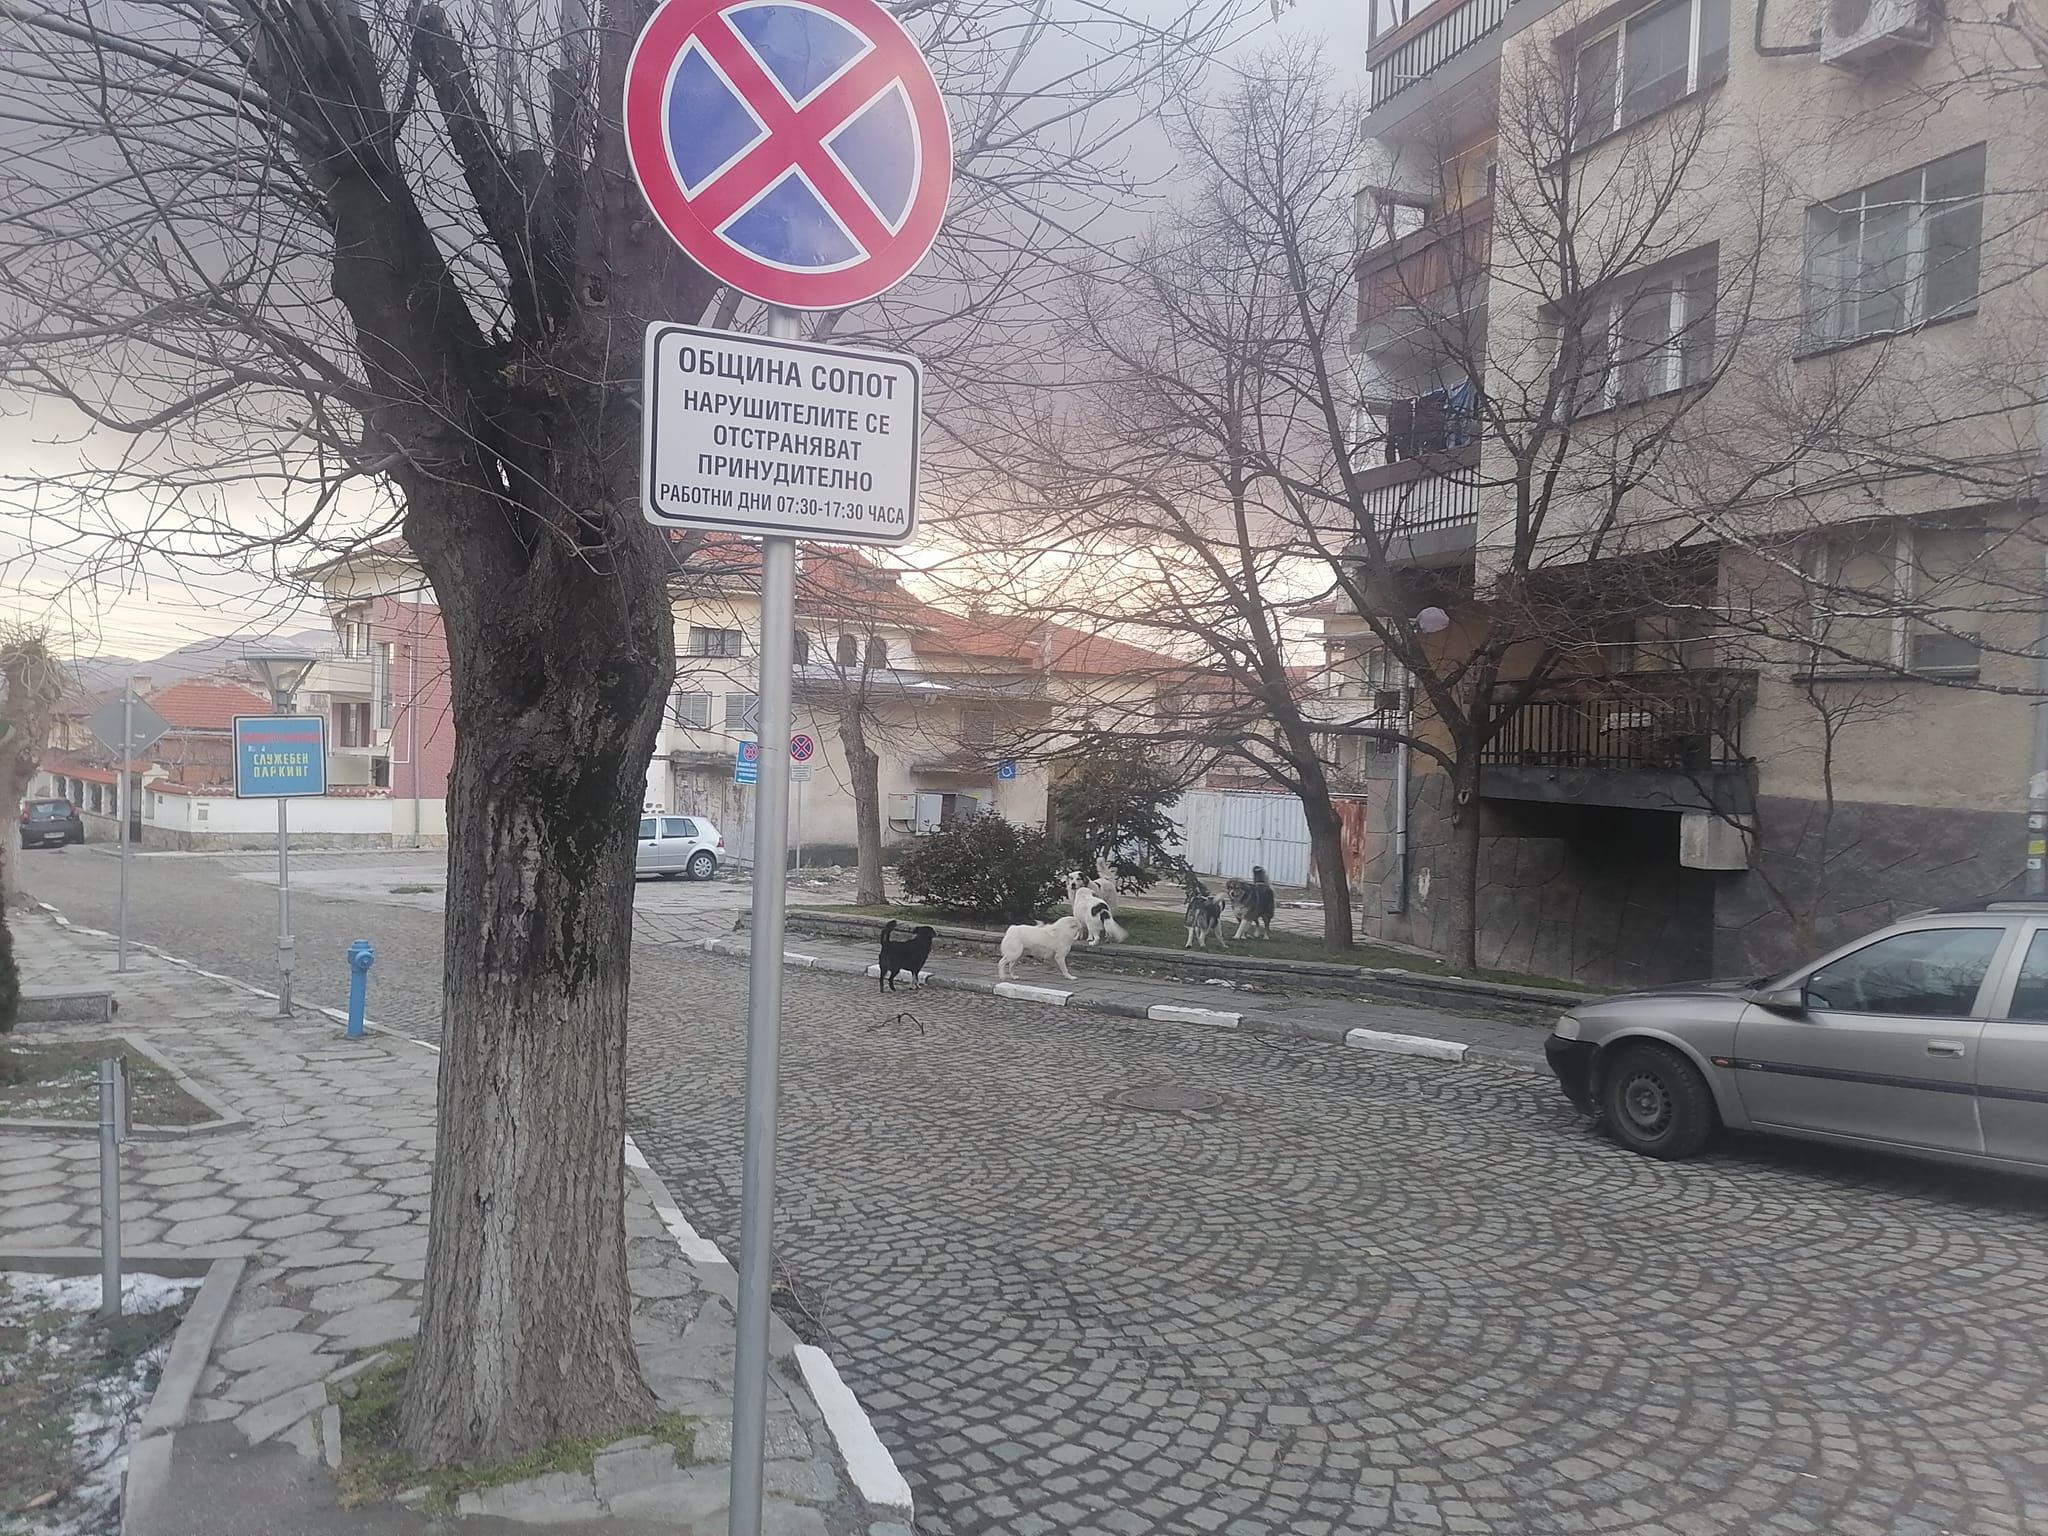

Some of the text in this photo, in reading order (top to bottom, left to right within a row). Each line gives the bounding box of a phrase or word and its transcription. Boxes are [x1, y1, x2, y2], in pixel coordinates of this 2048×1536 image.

[679, 347, 897, 400] ОБЩИНА СОПОТ
[684, 390, 890, 434] НАРУШИТЕЛИТЕ СЕ
[714, 425, 861, 460] ОТСТРАНЯВАТ
[699, 454, 872, 492] ПРИНУДИТЕЛНО
[661, 484, 904, 525] РАБОТНИ ДНИ 07:30-17:30 ЧАСА
[254, 753, 308, 765] СЛУЖЕБЕН
[254, 766, 308, 777] ПАРКИНГ
